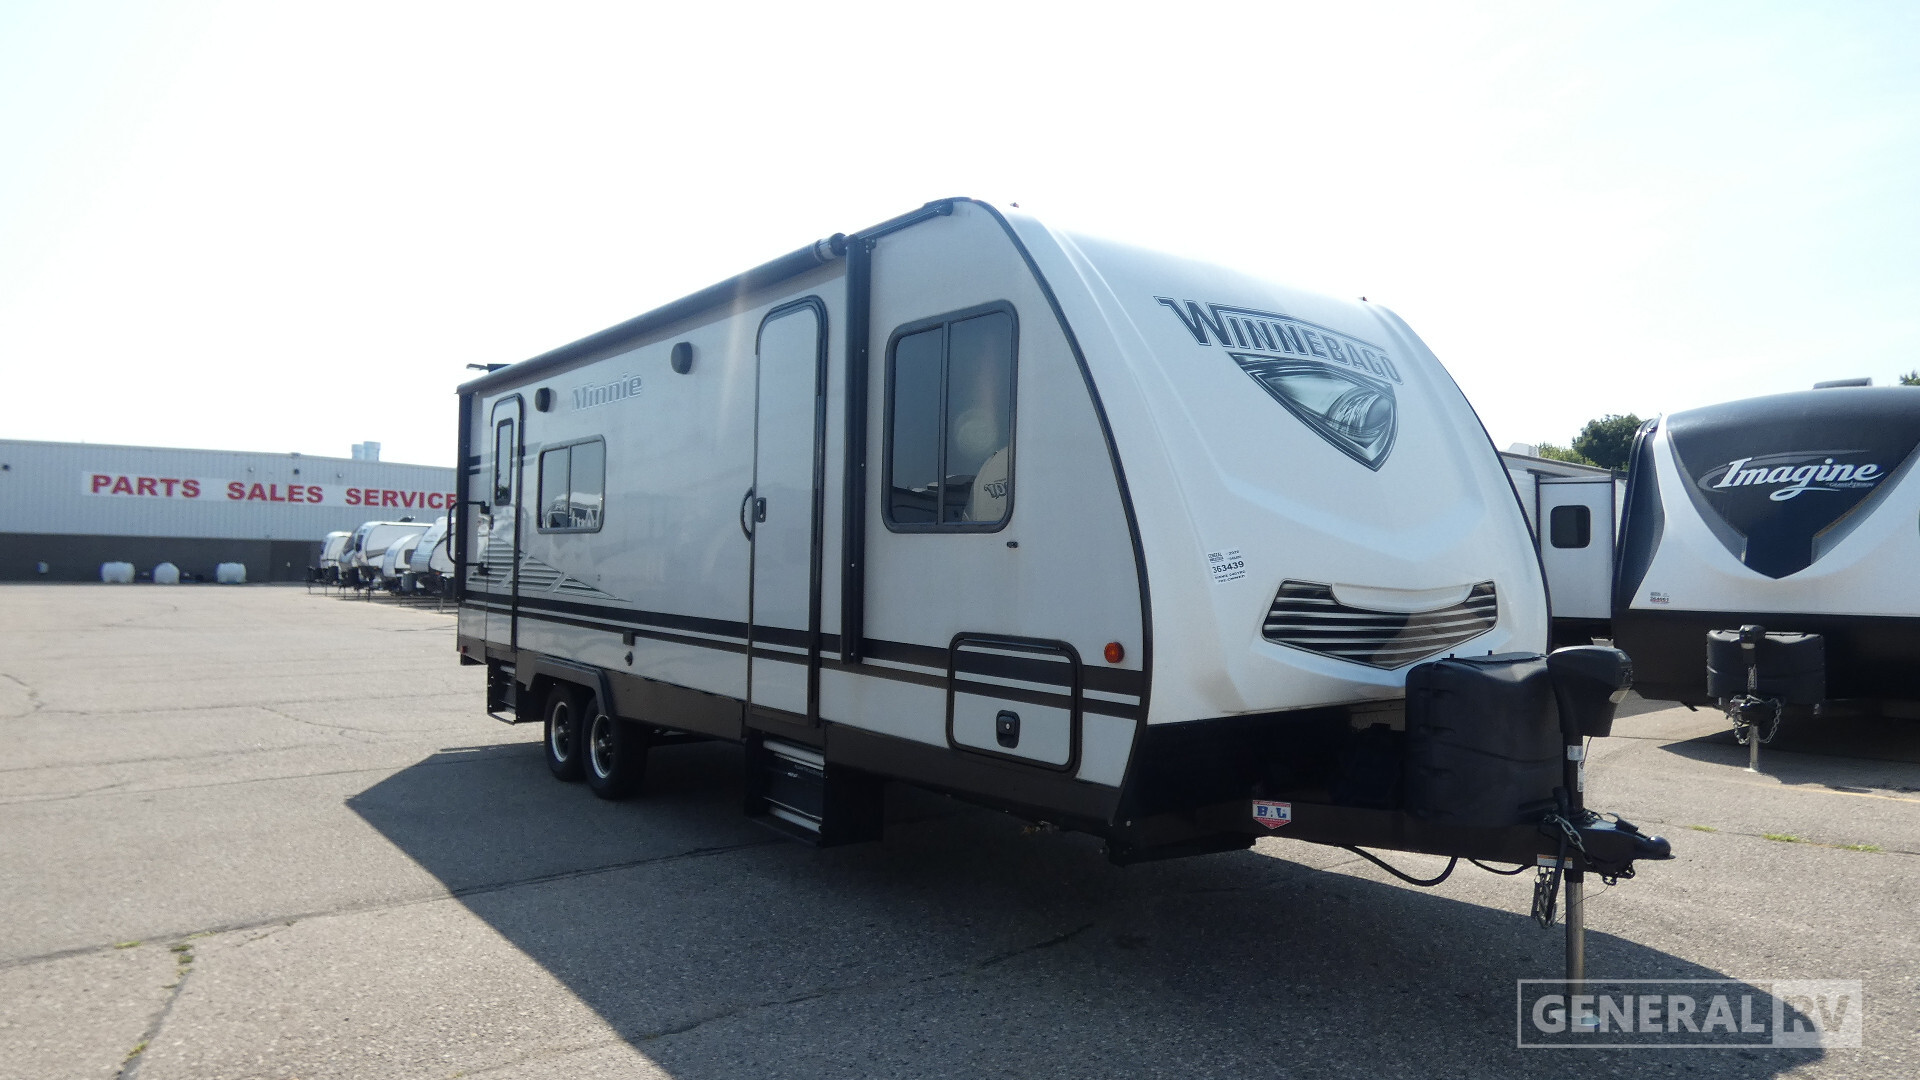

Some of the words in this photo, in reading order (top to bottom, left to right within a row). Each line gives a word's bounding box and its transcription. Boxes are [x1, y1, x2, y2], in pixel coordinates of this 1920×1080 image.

[1153, 296, 1402, 385] WINNEBAGO
[572, 373, 642, 412] Minnie
[91, 474, 200, 498] PARTS
[227, 482, 323, 504] SALES
[1713, 457, 1883, 501] Imagine
